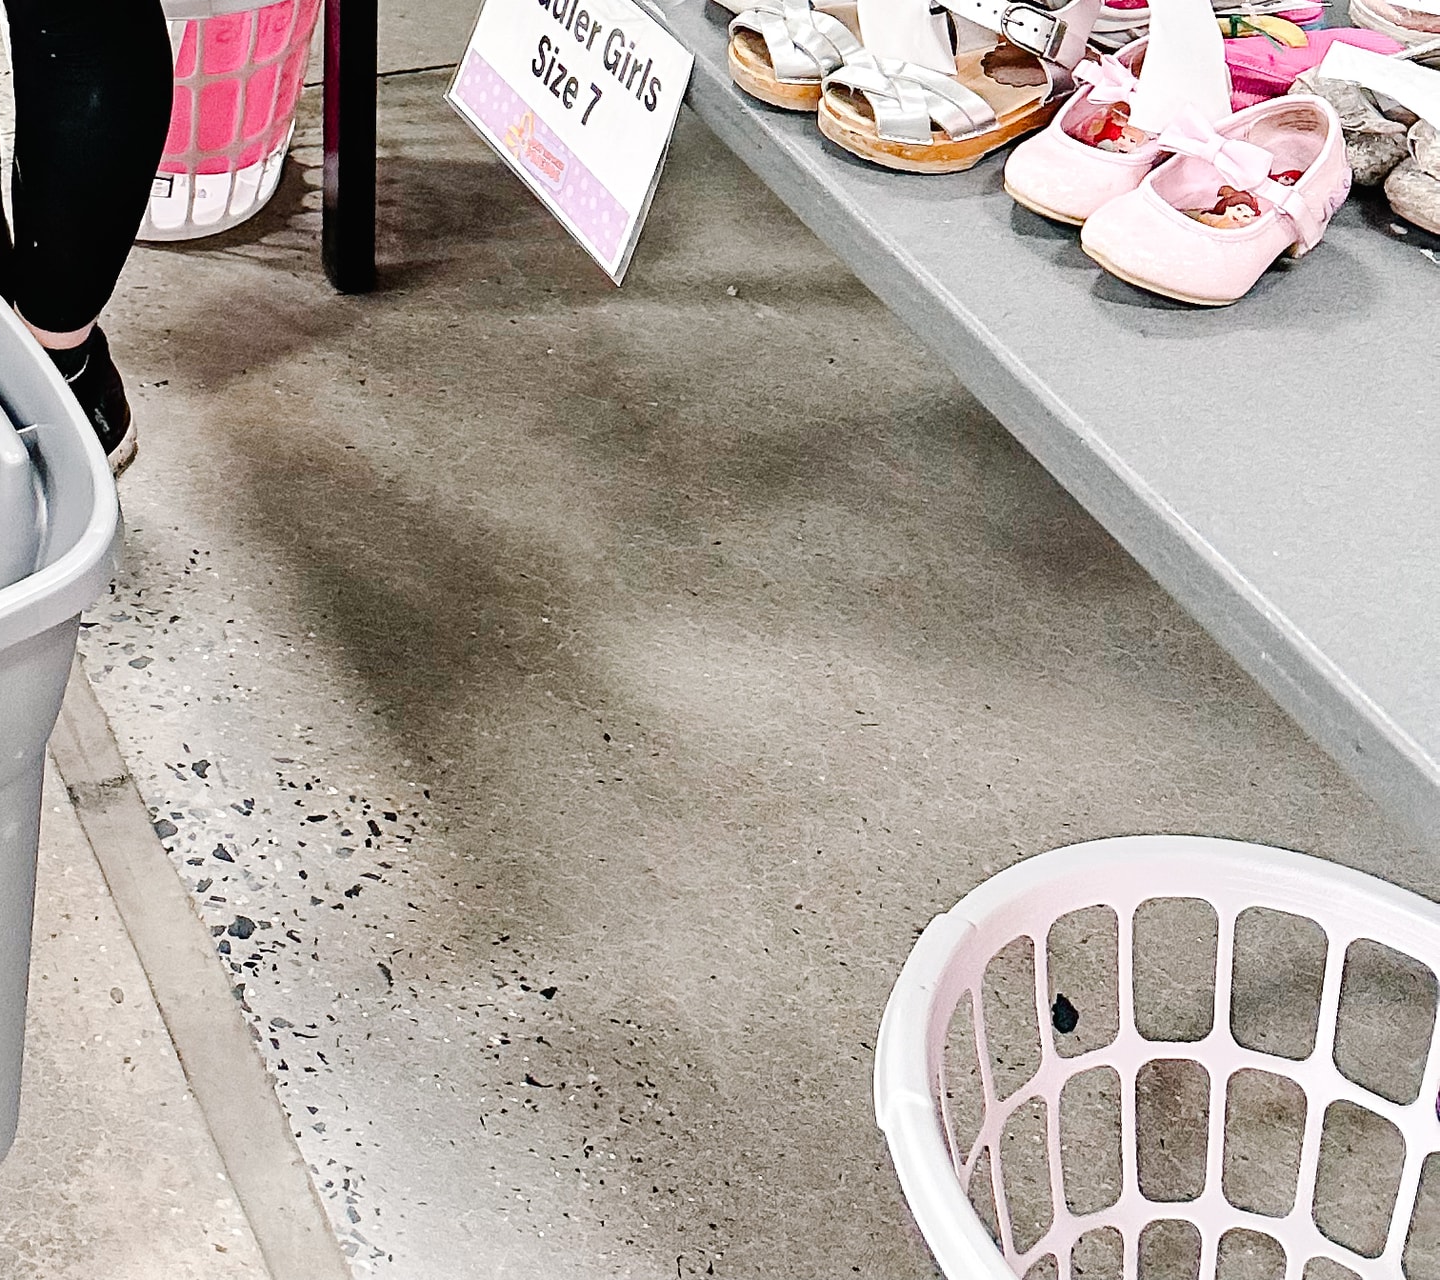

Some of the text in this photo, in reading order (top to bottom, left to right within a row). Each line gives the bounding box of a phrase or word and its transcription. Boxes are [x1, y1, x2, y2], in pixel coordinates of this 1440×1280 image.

[531, 34, 603, 127] Size 7
[602, 26, 663, 113] Girls
